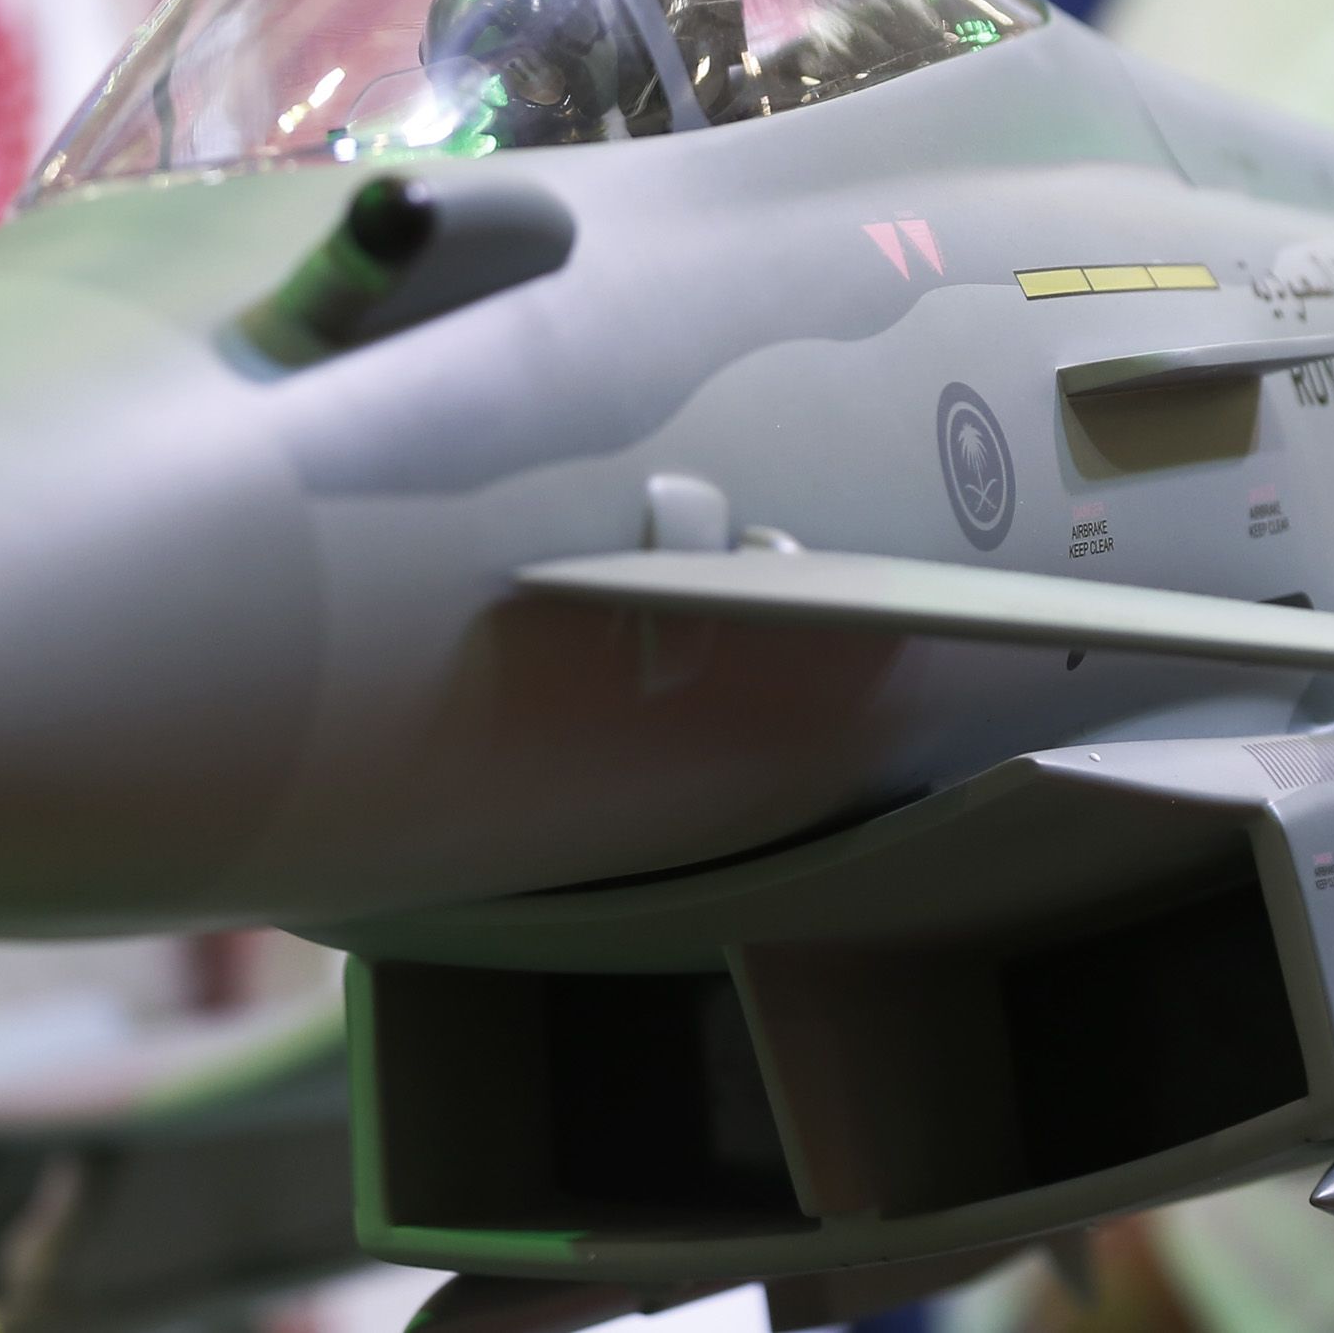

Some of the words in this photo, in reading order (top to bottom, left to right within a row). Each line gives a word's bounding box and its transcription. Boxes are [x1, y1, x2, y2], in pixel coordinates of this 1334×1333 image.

[1071, 519, 1108, 540] AIRBRAKE
[1068, 541, 1089, 559] KEEP
[1089, 537, 1115, 555] CLEAR
